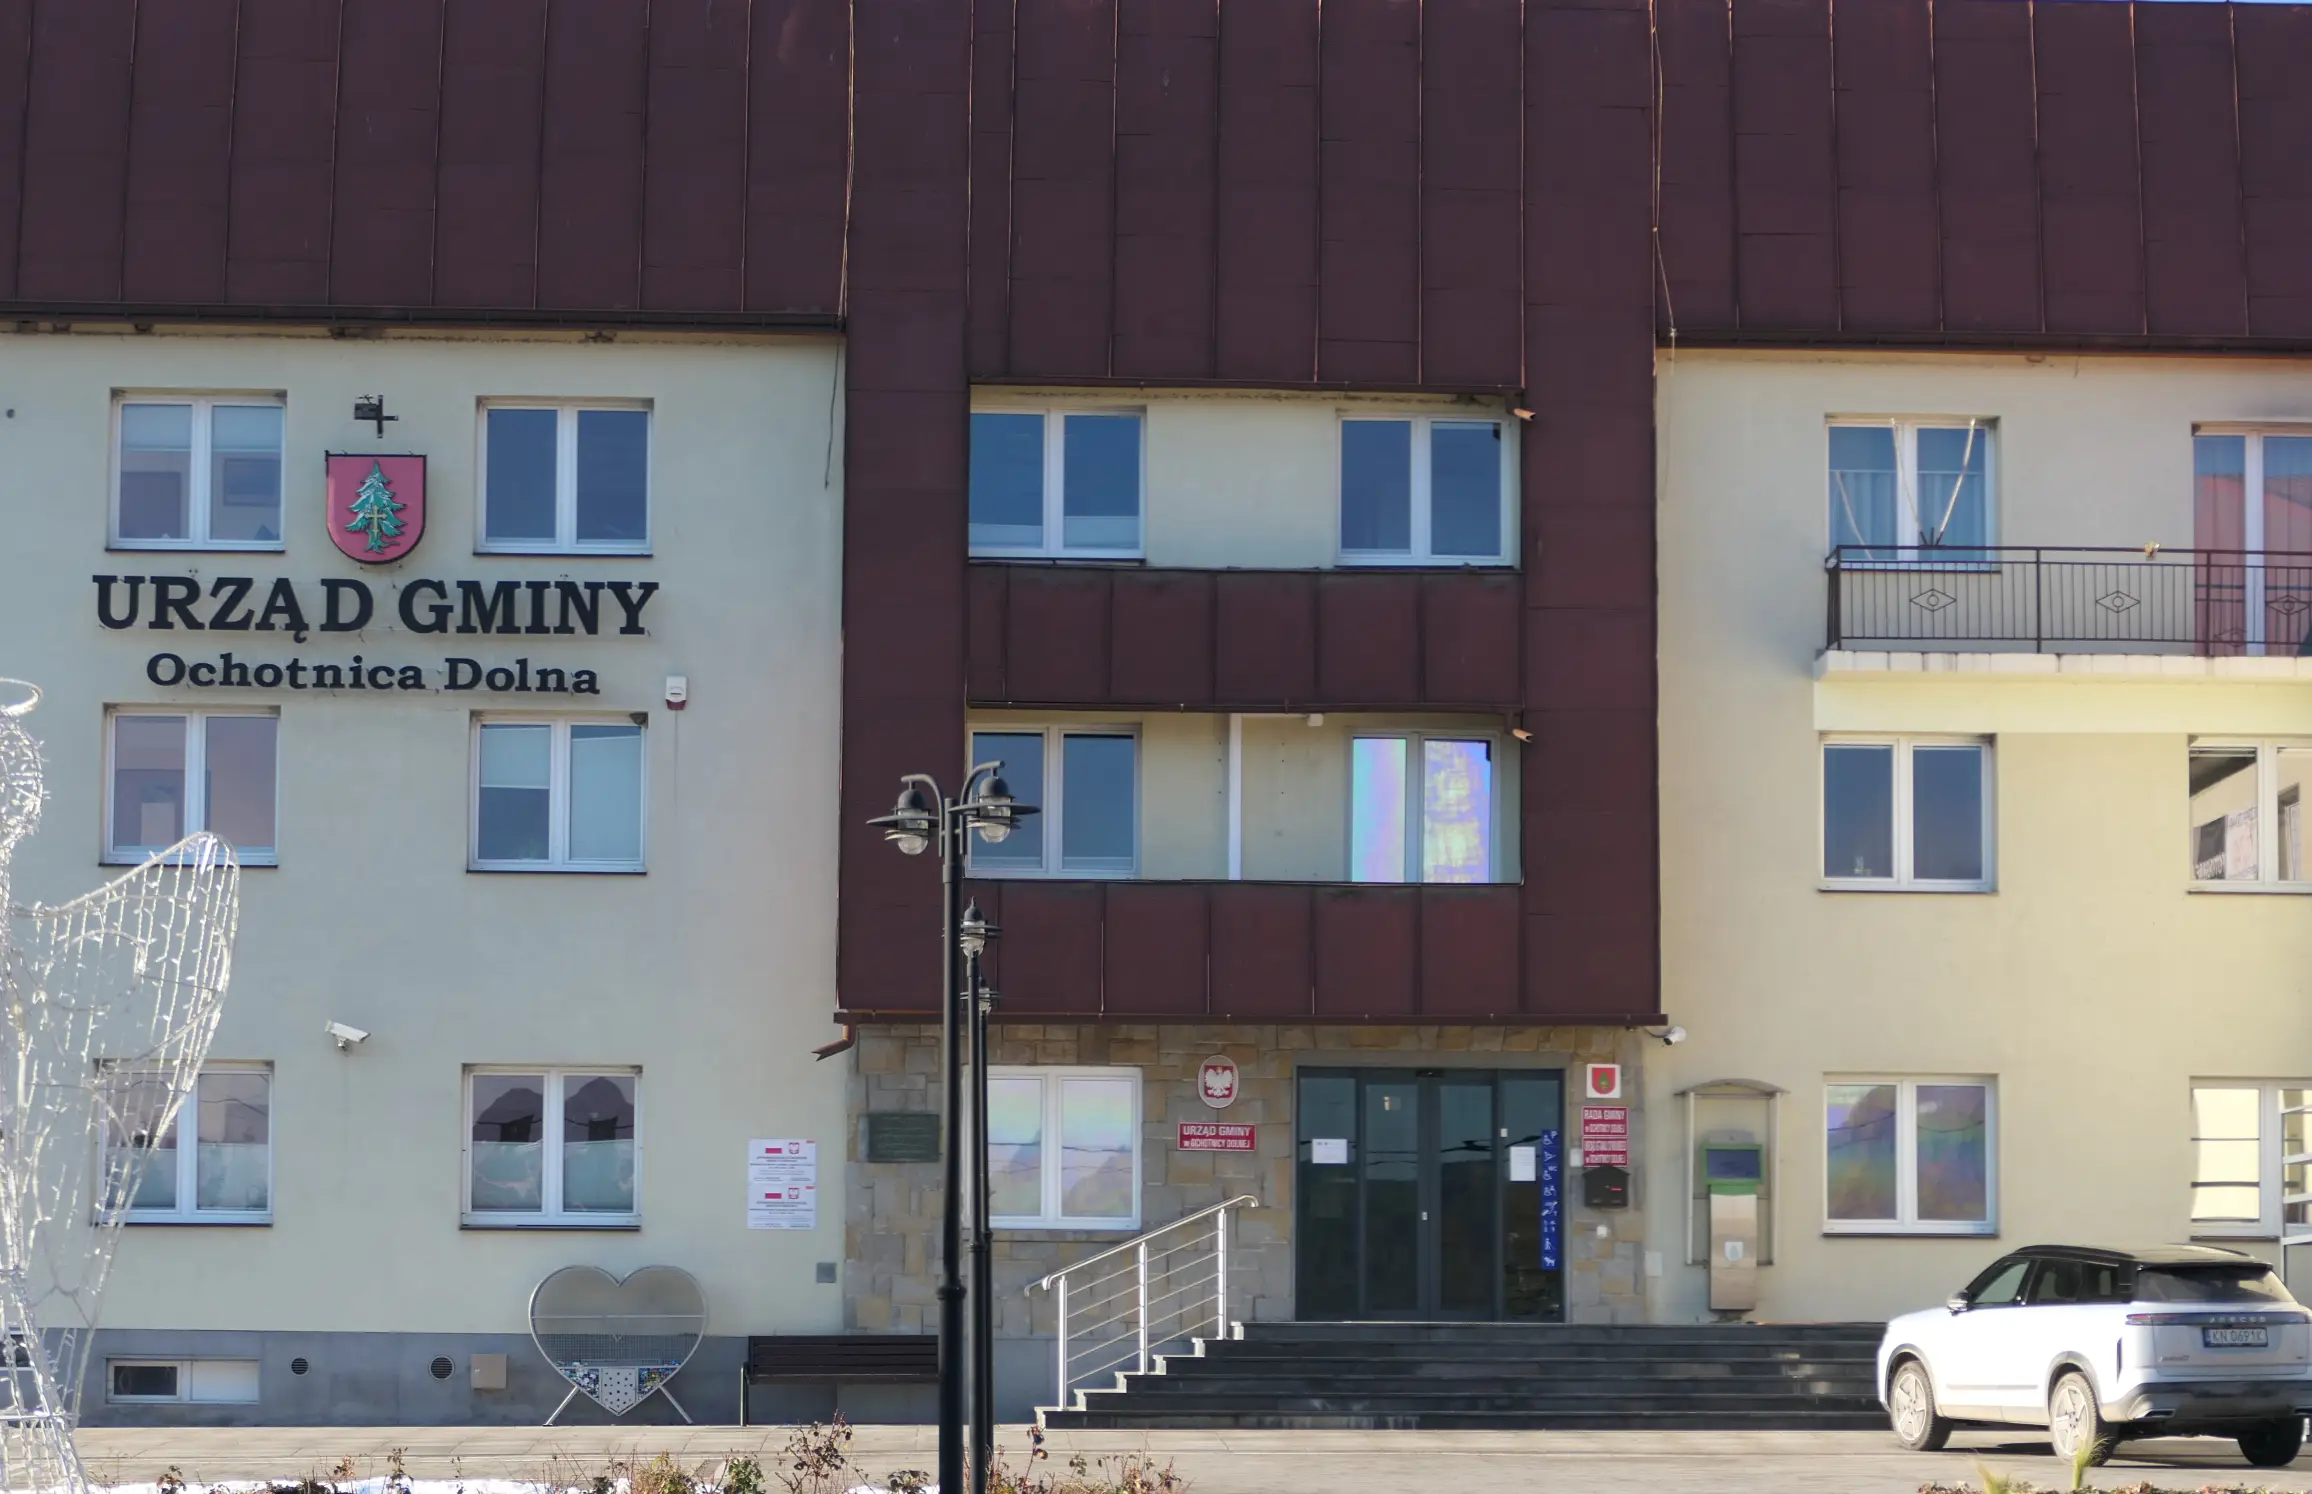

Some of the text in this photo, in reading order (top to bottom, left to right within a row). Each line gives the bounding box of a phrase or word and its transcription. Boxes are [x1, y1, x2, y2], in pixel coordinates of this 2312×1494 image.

[92, 575, 660, 643] URZĄD GMINY
[146, 653, 601, 695] Ochotnica Dolna
[1584, 1109, 1603, 1120] RADA
[1183, 1125, 1251, 1137] URZĄD GMINY
[2212, 1330, 2228, 1342] KN
